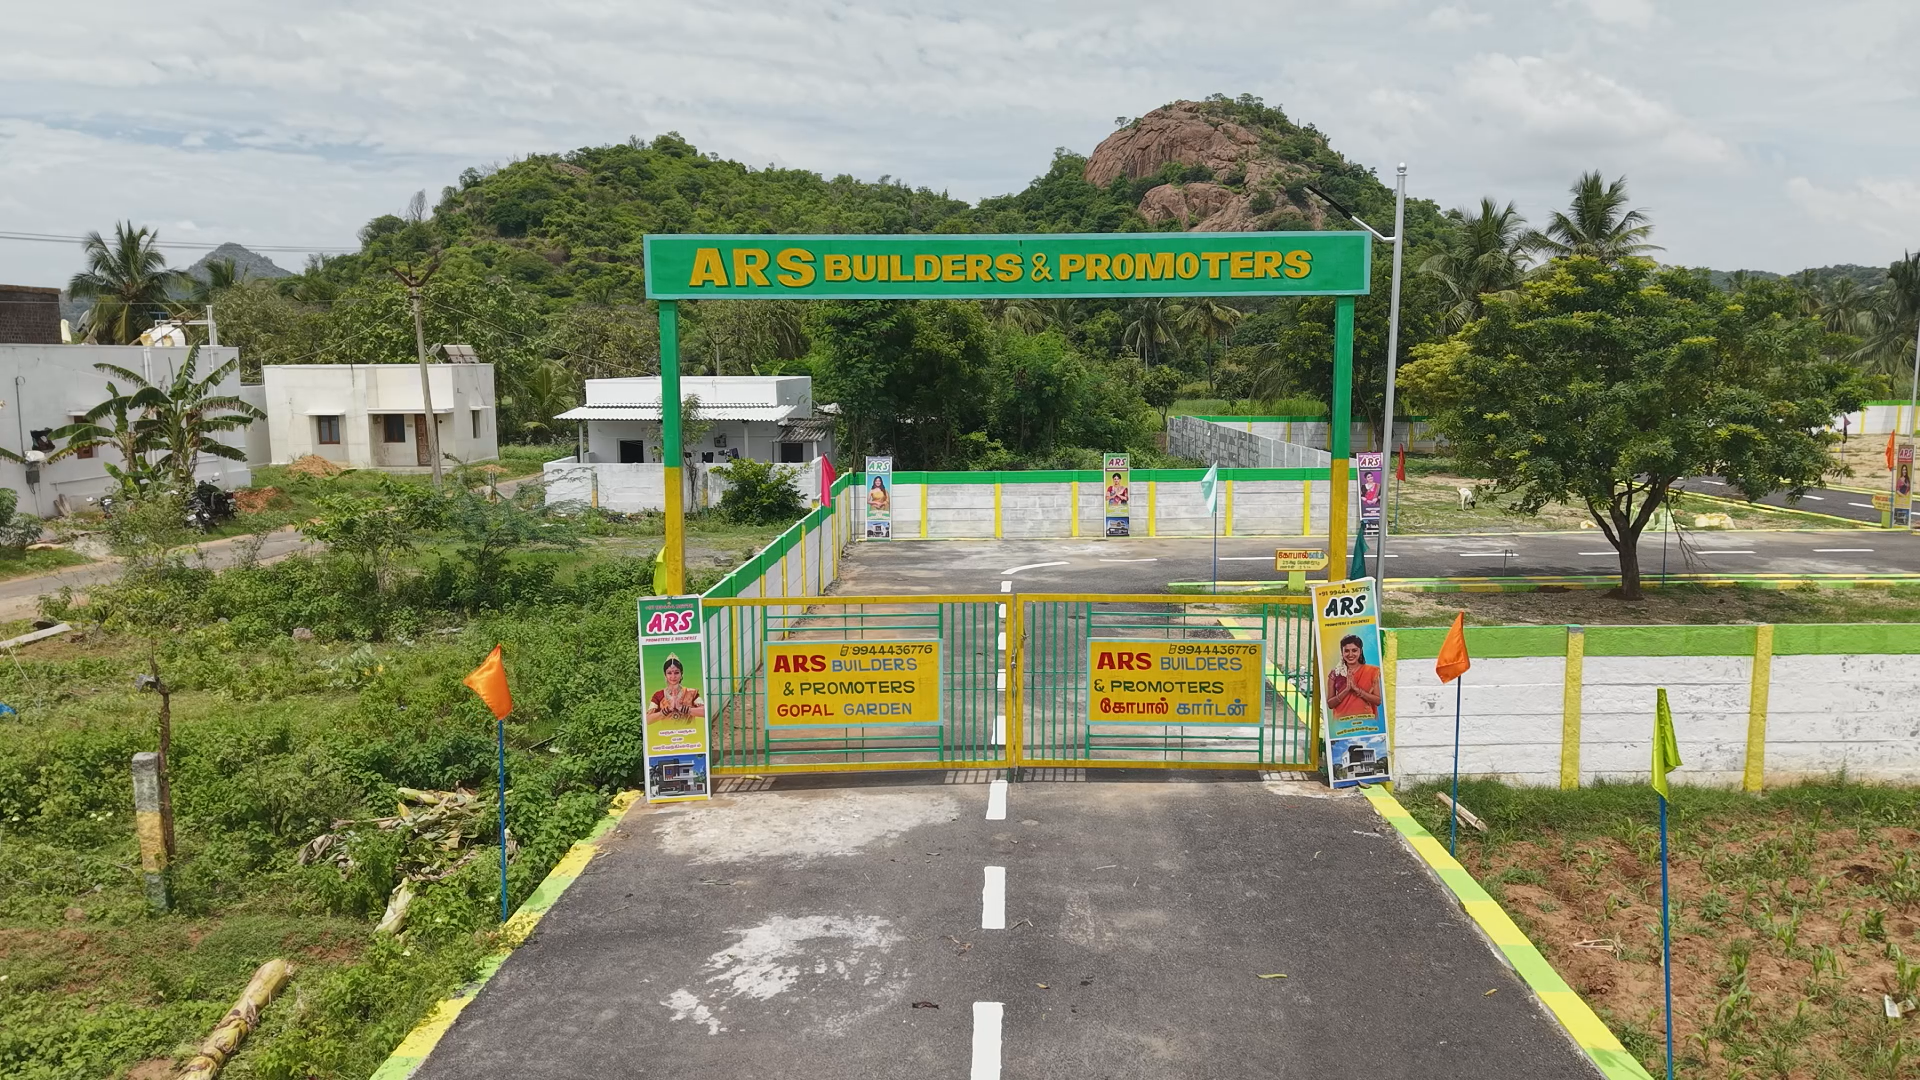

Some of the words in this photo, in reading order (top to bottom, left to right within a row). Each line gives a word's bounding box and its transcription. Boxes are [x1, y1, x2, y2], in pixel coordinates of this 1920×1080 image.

[689, 247, 816, 287] ARS
[825, 253, 1024, 283] BUILDERS
[1031, 252, 1053, 281] &
[1060, 250, 1313, 281] PROMOTERS
[1900, 449, 1913, 458] ARS
[868, 461, 890, 471] ARS
[1108, 458, 1126, 466] ARS
[1361, 458, 1380, 467] ARS
[1325, 595, 1367, 617] ARS
[647, 611, 694, 634] ARS
[852, 644, 933, 656] 9944436776
[1177, 644, 1257, 656] 9944436776
[773, 655, 826, 673] ARS
[831, 658, 918, 673] BUILDERS
[1097, 652, 1152, 671] ARS
[1160, 656, 1243, 671] BUILDERS
[783, 682, 795, 696] &
[799, 680, 916, 696] PROMOTERS
[1094, 679, 1106, 693] &
[1111, 680, 1224, 694] PROMOTERS
[777, 704, 834, 718] GOPAL
[843, 703, 912, 716] GARDEN
[1100, 697, 1169, 715] கோபால்
[1176, 699, 1248, 717] கார்டன்
